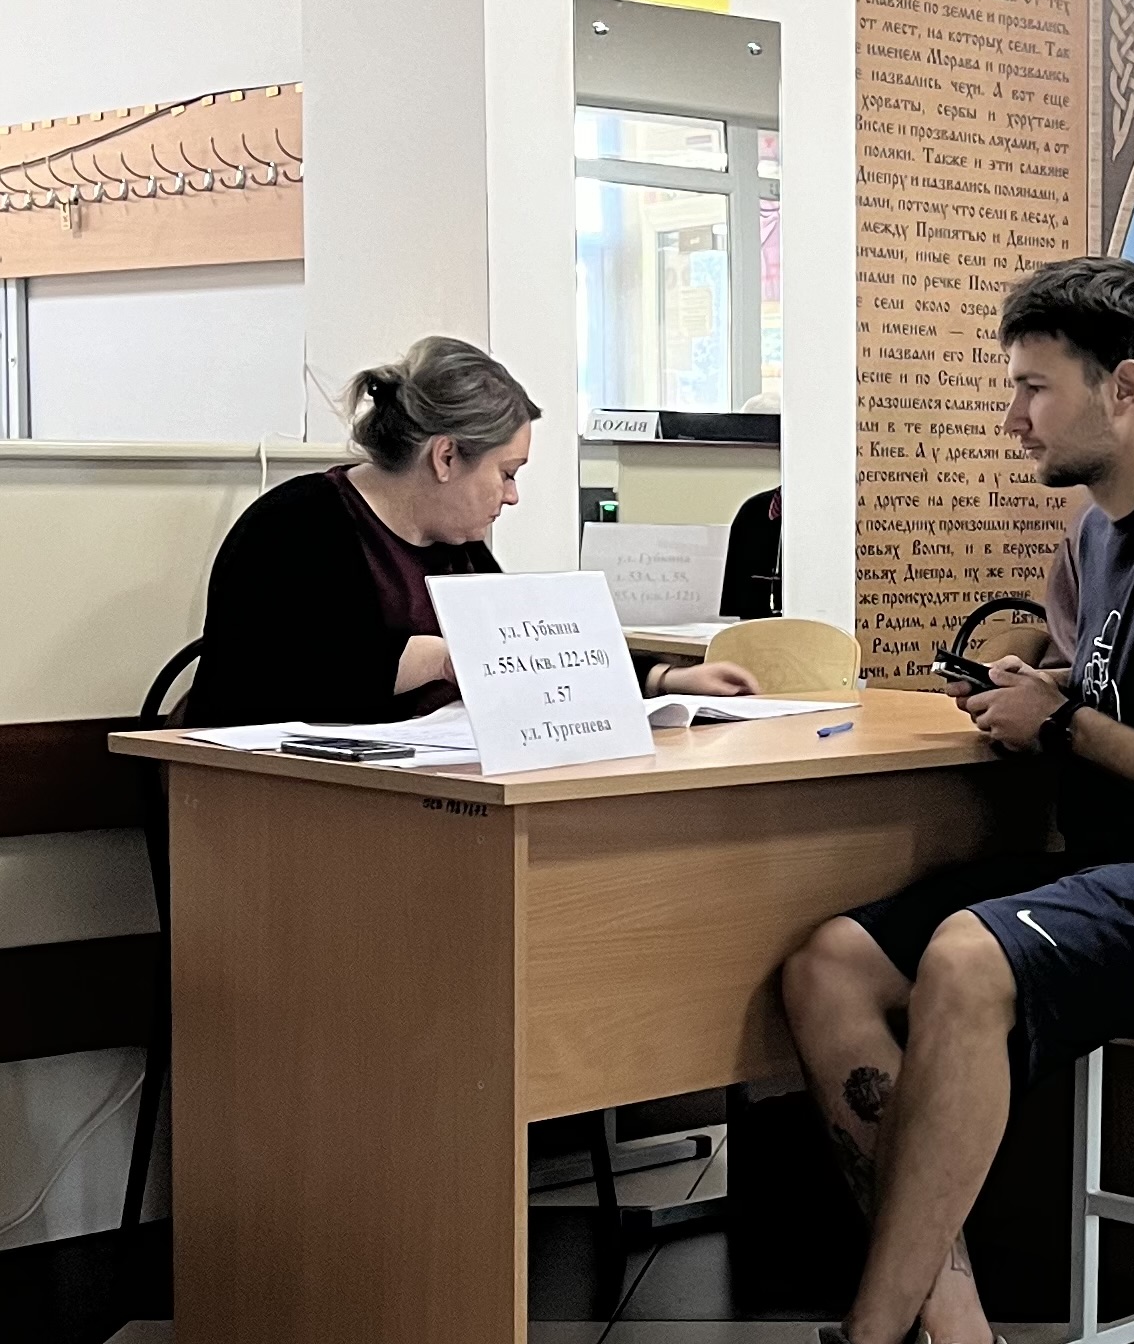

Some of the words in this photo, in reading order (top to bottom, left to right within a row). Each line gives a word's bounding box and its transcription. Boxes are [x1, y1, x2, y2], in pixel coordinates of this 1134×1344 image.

[924, 1, 938, 14] по
[942, 5, 983, 22] земле
[999, 14, 1070, 35] прозвались
[859, 17, 877, 30] от
[882, 21, 921, 39] мест,
[927, 28, 943, 40] на
[949, 31, 1003, 54] которых
[1008, 40, 1040, 55] сели.
[1045, 41, 1070, 59] Так
[867, 44, 921, 62] именем
[927, 48, 980, 70] Морава
[986, 61, 993, 72] и
[999, 62, 1070, 83] прозвались
[871, 70, 941, 90] назвались
[951, 80, 984, 99] чехи.
[993, 81, 1002, 98] А
[1012, 89, 1035, 102] вот
[1044, 94, 1070, 107] еще
[861, 93, 925, 115] хорваты,
[938, 103, 977, 121] сербы
[1007, 112, 1070, 131] хорутане.
[856, 114, 894, 134] Висле
[898, 123, 905, 135] и
[910, 125, 985, 145] прозвались
[989, 135, 1040, 153] ляхами,
[1054, 143, 1069, 154] от
[864, 144, 915, 161] поляки.
[922, 147, 968, 167] Также
[974, 156, 982, 168] и
[988, 160, 1013, 172] эти
[1020, 161, 1069, 179] славяне
[856, 165, 908, 191] Днепру
[922, 175, 990, 194] назвались
[994, 184, 1060, 203] полянами,
[1062, 192, 1069, 202] а
[898, 198, 948, 220] потому
[952, 205, 975, 217] что
[979, 207, 1007, 220] сели
[1010, 211, 1017, 221] в
[1021, 212, 1058, 229] лесах,
[861, 220, 909, 241] между
[916, 221, 986, 242] Припятью
[992, 232, 1000, 242] и
[1007, 230, 1055, 249] Двиною
[916, 250, 950, 264] иные
[958, 254, 986, 267] сели
[993, 255, 1007, 268] по
[902, 274, 916, 286] по
[924, 276, 961, 291] речке
[969, 275, 1008, 293] Полот
[874, 296, 904, 309] сели
[915, 300, 950, 312] около
[961, 303, 997, 320] озера
[882, 323, 937, 336] именем
[863, 346, 870, 358] и
[880, 347, 934, 361] назвали
[943, 350, 964, 362] его
[973, 348, 1010, 364] Новго
[916, 373, 930, 385] по
[938, 370, 982, 392] Сейму
[988, 377, 996, 387] и
[869, 396, 941, 411] разошелся
[945, 400, 1010, 412] славянск
[888, 422, 895, 433] в
[904, 423, 922, 433] те
[931, 423, 986, 436] времена
[870, 441, 908, 457] Киев.
[916, 442, 925, 458] А
[932, 447, 940, 463] у
[946, 447, 999, 462] древлян
[856, 469, 928, 485] реговичей
[937, 471, 969, 484] свое,
[994, 473, 1001, 487] у
[1010, 472, 1037, 484] слав
[874, 495, 920, 510] другое
[928, 495, 943, 507] на
[952, 496, 980, 510] реке
[988, 492, 1038, 509] Полота,
[1046, 497, 1067, 510] где
[866, 520, 935, 535] последних
[939, 520, 1009, 535] произошли
[912, 540, 954, 556] Волги,
[984, 544, 992, 554] в
[1003, 543, 1060, 559] верховья
[856, 567, 896, 584] овьях
[904, 564, 956, 581] Днепра,
[965, 568, 979, 583] их
[986, 568, 1004, 578] же
[1012, 567, 1044, 582] город
[882, 591, 960, 609] происходят
[963, 591, 970, 602] и
[499, 626, 521, 644] ул.
[522, 619, 580, 641] Губкина
[876, 613, 924, 629] Радим,
[872, 638, 920, 655] Радим
[932, 640, 947, 650] на
[483, 663, 495, 677] д.
[499, 657, 527, 674] 55А
[530, 659, 556, 676] (кв.
[559, 649, 610, 669] 122-150)
[859, 666, 888, 680] ичи,
[894, 666, 901, 676] а
[544, 691, 555, 705] д.
[557, 685, 571, 703] 57
[520, 727, 541, 746] ул.
[543, 718, 612, 742] Тургенева
